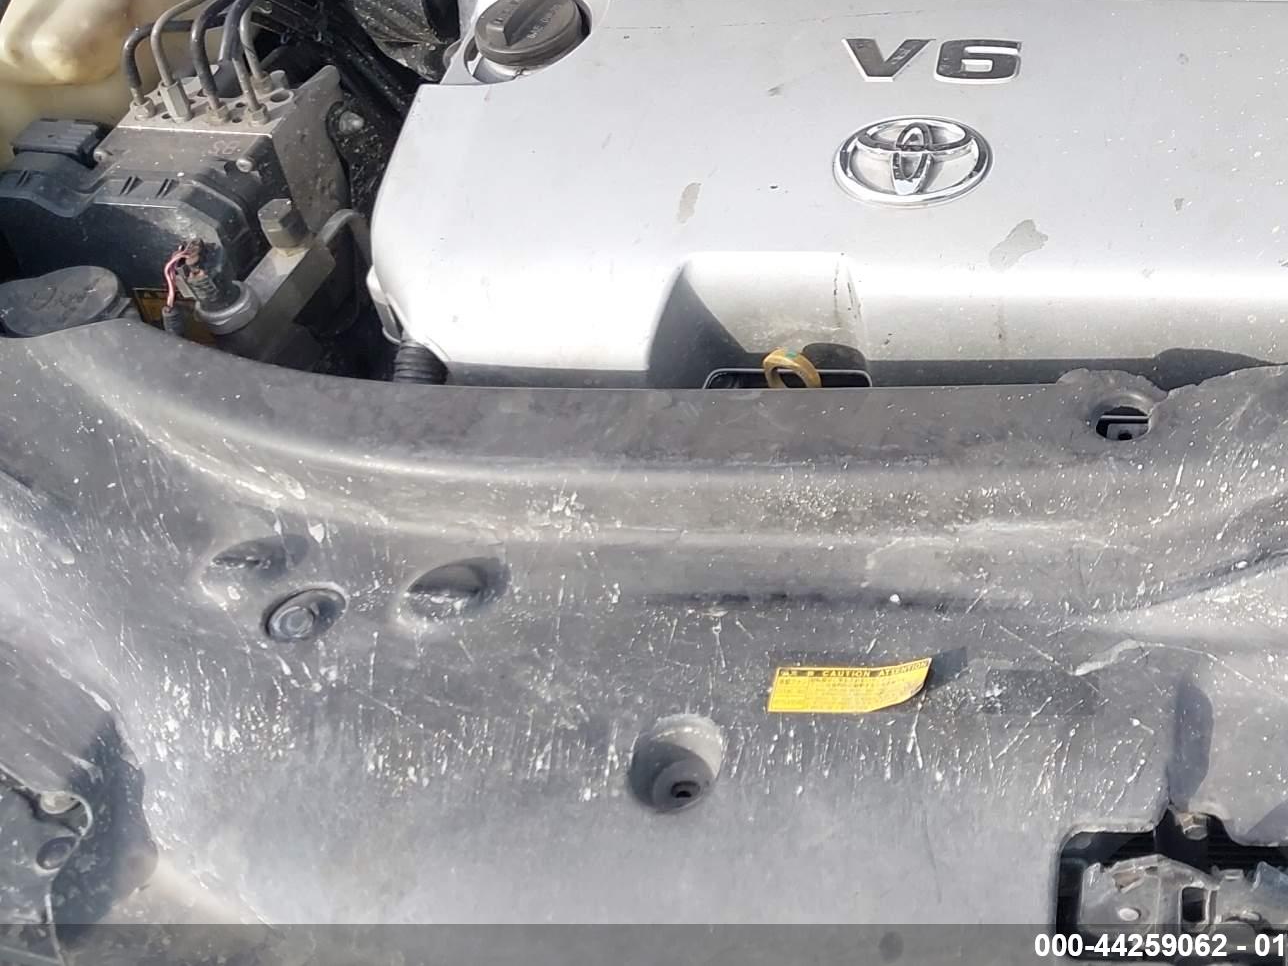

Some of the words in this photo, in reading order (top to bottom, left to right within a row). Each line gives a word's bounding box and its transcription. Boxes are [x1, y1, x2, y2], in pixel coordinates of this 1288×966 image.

[841, 37, 1023, 85] V6
[822, 670, 871, 678] CAUTION
[878, 661, 929, 678] ATTENTION
